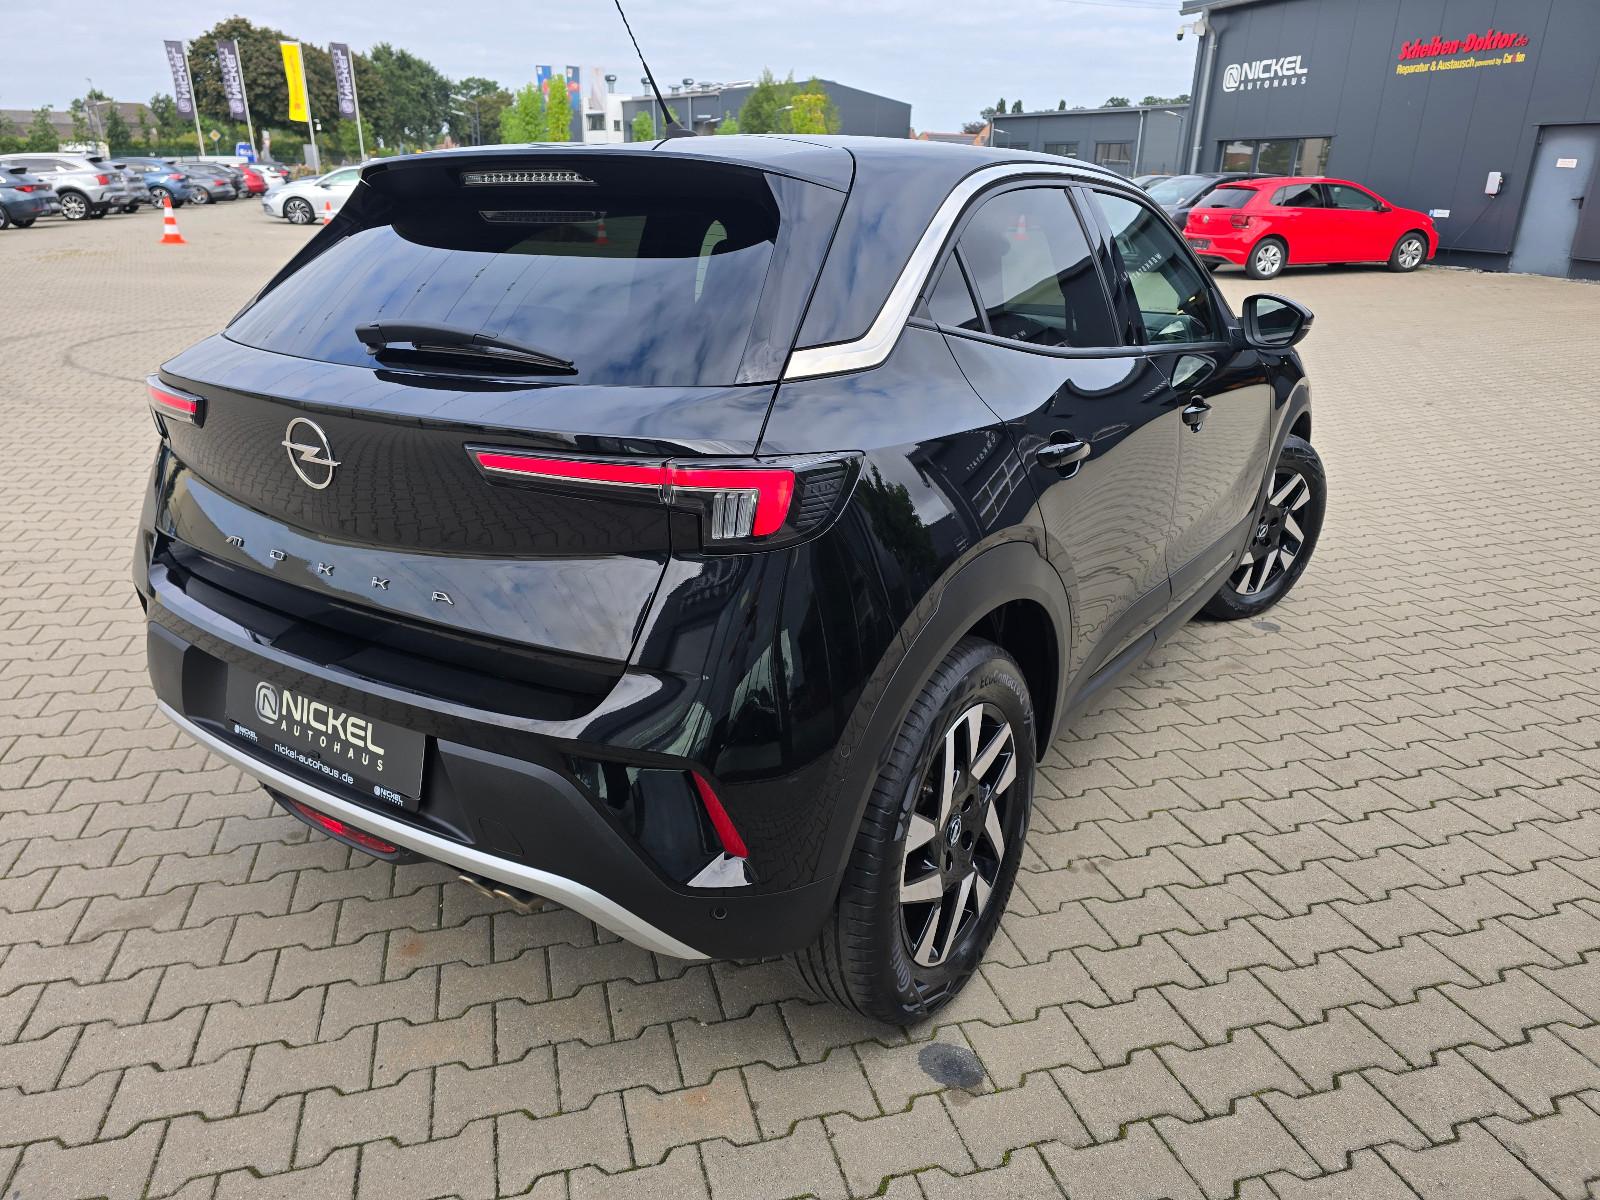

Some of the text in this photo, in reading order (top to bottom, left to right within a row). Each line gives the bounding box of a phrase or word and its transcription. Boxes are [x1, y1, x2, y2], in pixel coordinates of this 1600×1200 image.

[1398, 28, 1529, 60] Scheiben-Doktor.de
[1241, 55, 1308, 80] NICKEL
[1396, 62, 1429, 75] Reparatur
[1430, 61, 1436, 71] &
[1437, 57, 1475, 70] Austausch
[1239, 76, 1307, 90] AUTOHAUS
[282, 690, 384, 756] NICKEL
[280, 720, 383, 771] AUTOHAUS
[274, 743, 354, 784] nickel-autohaus.de
